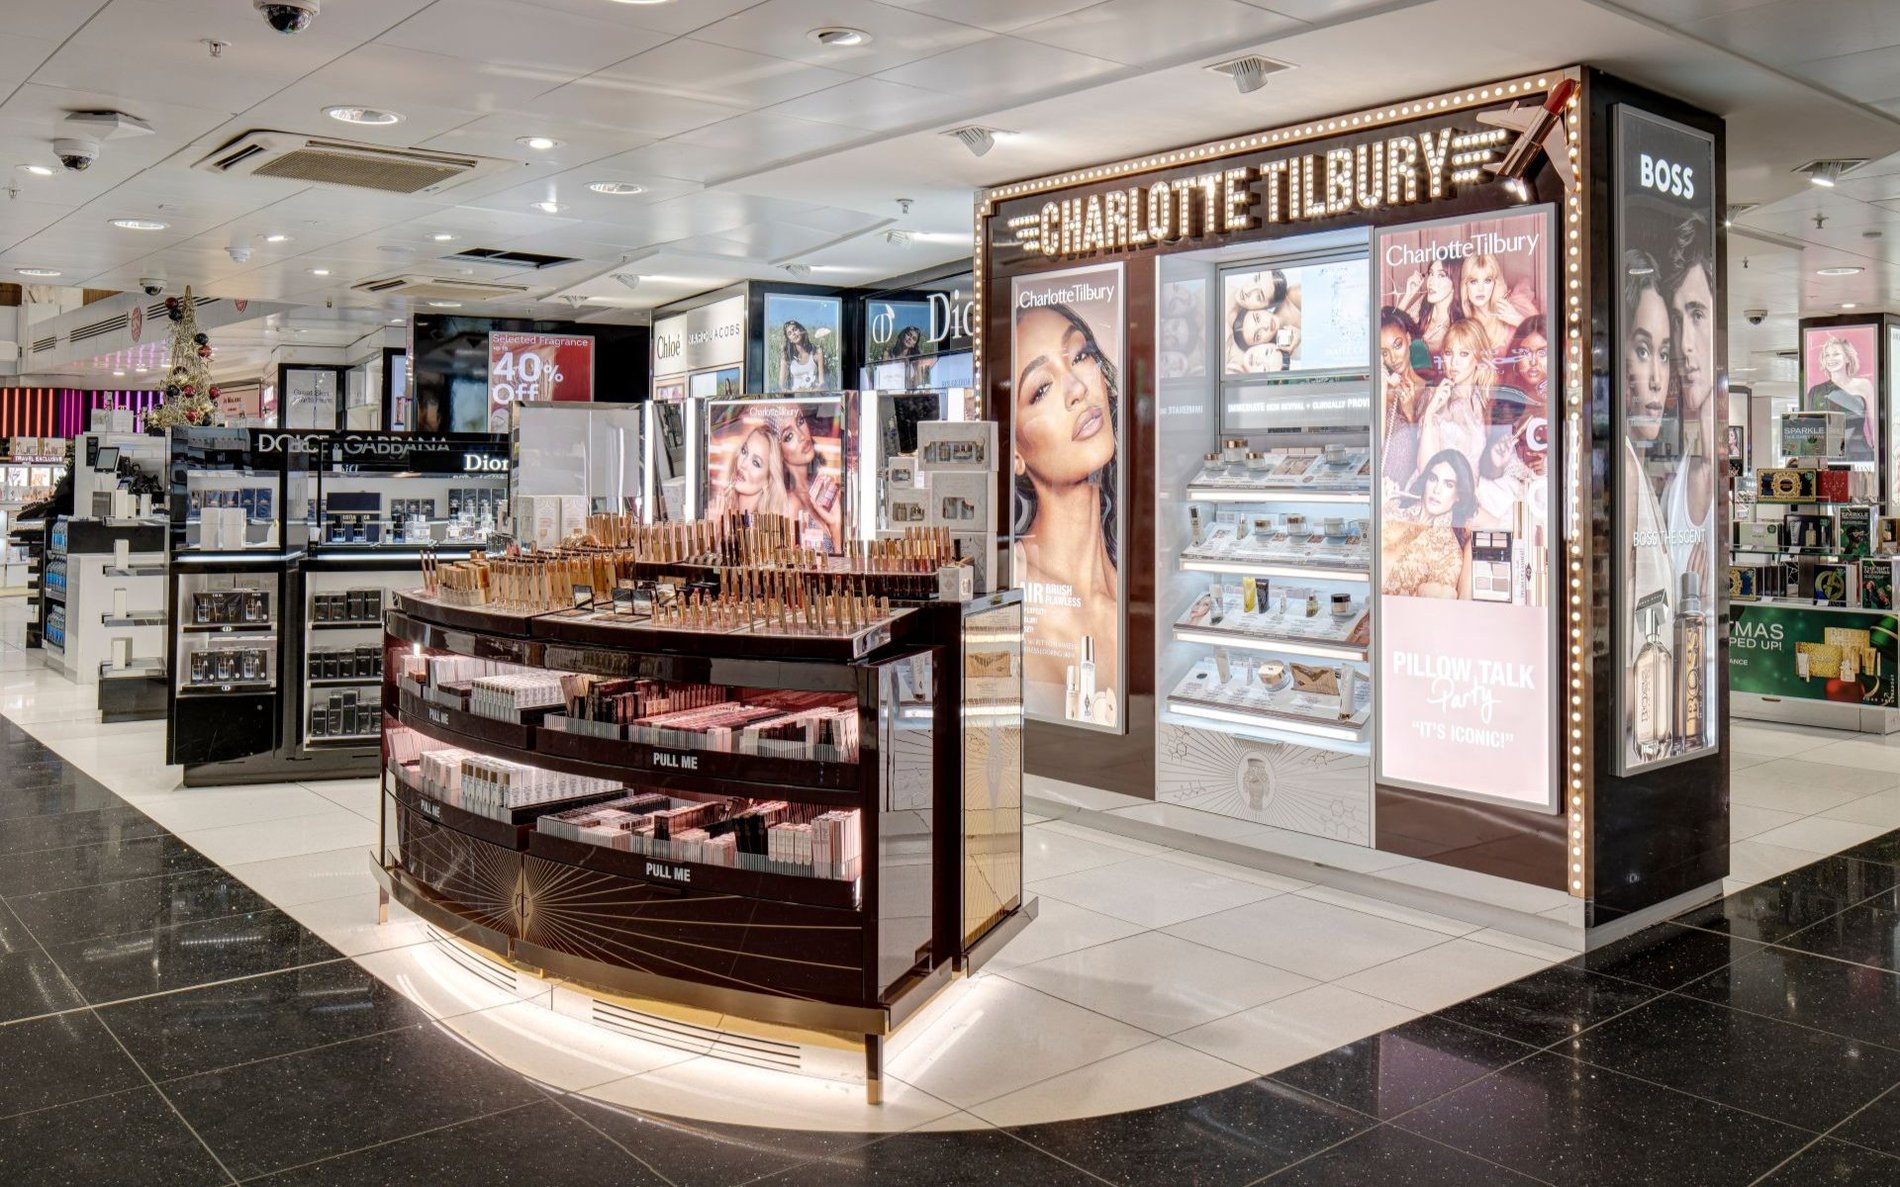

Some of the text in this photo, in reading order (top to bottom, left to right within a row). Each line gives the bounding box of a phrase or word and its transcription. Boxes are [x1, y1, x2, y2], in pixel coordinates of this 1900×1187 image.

[1641, 153, 1694, 200] BOSS
[1041, 127, 1452, 256] CHARLOTTE TILBURY
[926, 289, 974, 343] Dio
[493, 334, 588, 347] Selected Fragrance
[688, 323, 740, 345] MARC JACOBS
[656, 334, 681, 360] Chloé
[493, 351, 564, 382] 40%
[492, 383, 539, 405] Off
[1228, 403, 1265, 413] IMMEDIATE
[1784, 426, 1825, 435] SPARKLE
[344, 434, 450, 456] GABBANA
[464, 454, 509, 471] Dior
[1633, 528, 1706, 546] BOSS THE SCENT
[1045, 583, 1072, 596] BRUSH
[1045, 596, 1081, 608] FLAWLESS
[1729, 620, 1784, 640] MAS
[1729, 637, 1783, 651] PED UP!
[1393, 650, 1536, 690] PILLOW TALK
[1729, 658, 1749, 666] ANCE
[1426, 676, 1503, 724] Party
[429, 707, 449, 725] PULL ME
[653, 752, 698, 770] PULL ME
[420, 799, 440, 819] PULL ME
[646, 862, 691, 883] PULL ME
